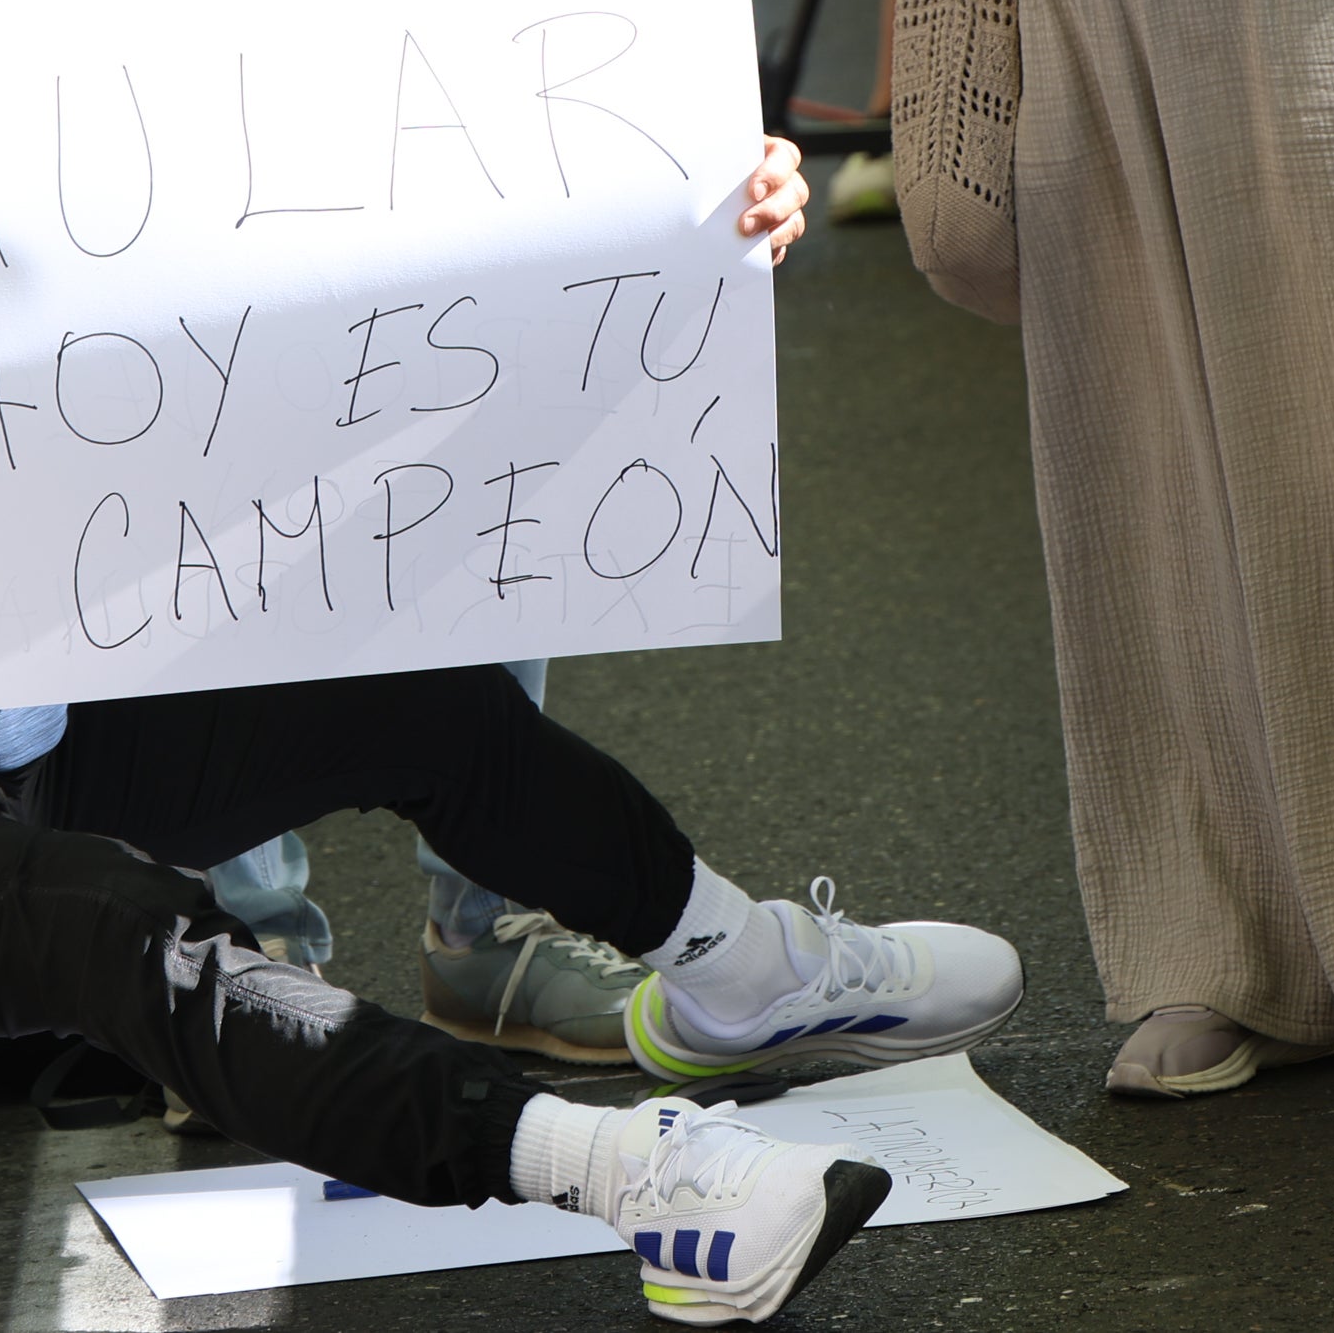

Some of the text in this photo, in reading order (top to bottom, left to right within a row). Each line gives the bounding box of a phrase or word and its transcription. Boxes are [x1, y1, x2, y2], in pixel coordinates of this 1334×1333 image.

[336, 295, 499, 427] ES
[563, 270, 724, 391] TU
[73, 396, 780, 649] CAMPEÓN
[673, 931, 726, 967] adidas
